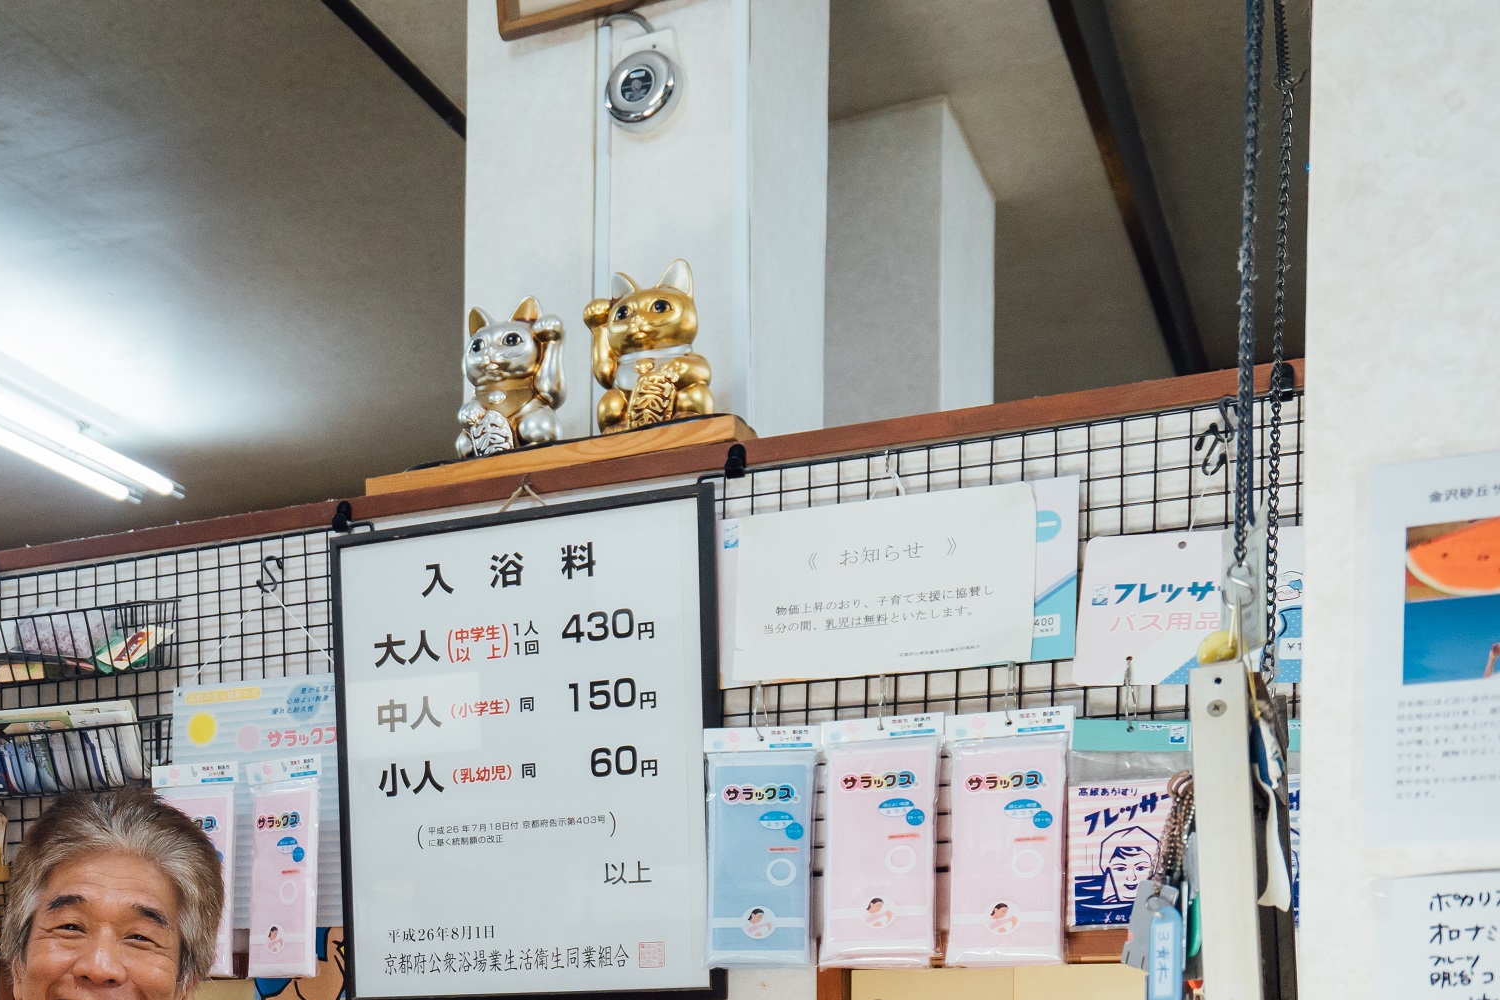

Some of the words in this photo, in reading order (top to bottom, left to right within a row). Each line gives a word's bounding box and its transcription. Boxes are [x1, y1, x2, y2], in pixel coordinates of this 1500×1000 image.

[839, 541, 924, 567] お知らせ
[1114, 581, 1221, 605] フレッサ
[513, 620, 539, 637] 1人
[1109, 612, 1221, 633] バス用品
[373, 629, 441, 668] 大人
[561, 608, 655, 643] 430円
[513, 639, 540, 656] 1回
[377, 695, 443, 733] 中人
[519, 696, 535, 712] 同
[568, 677, 657, 712] 150円
[378, 760, 445, 797] 小人
[521, 762, 536, 779] 同
[590, 745, 658, 778] 60円
[843, 773, 913, 790] サラックス
[967, 773, 1039, 790] サラックス
[725, 787, 792, 801] サラックス
[257, 811, 299, 830] サラックス
[428, 834, 504, 847] に基く統制額の改正
[603, 860, 652, 885] 以上
[387, 925, 495, 944] 平成26年8月1日
